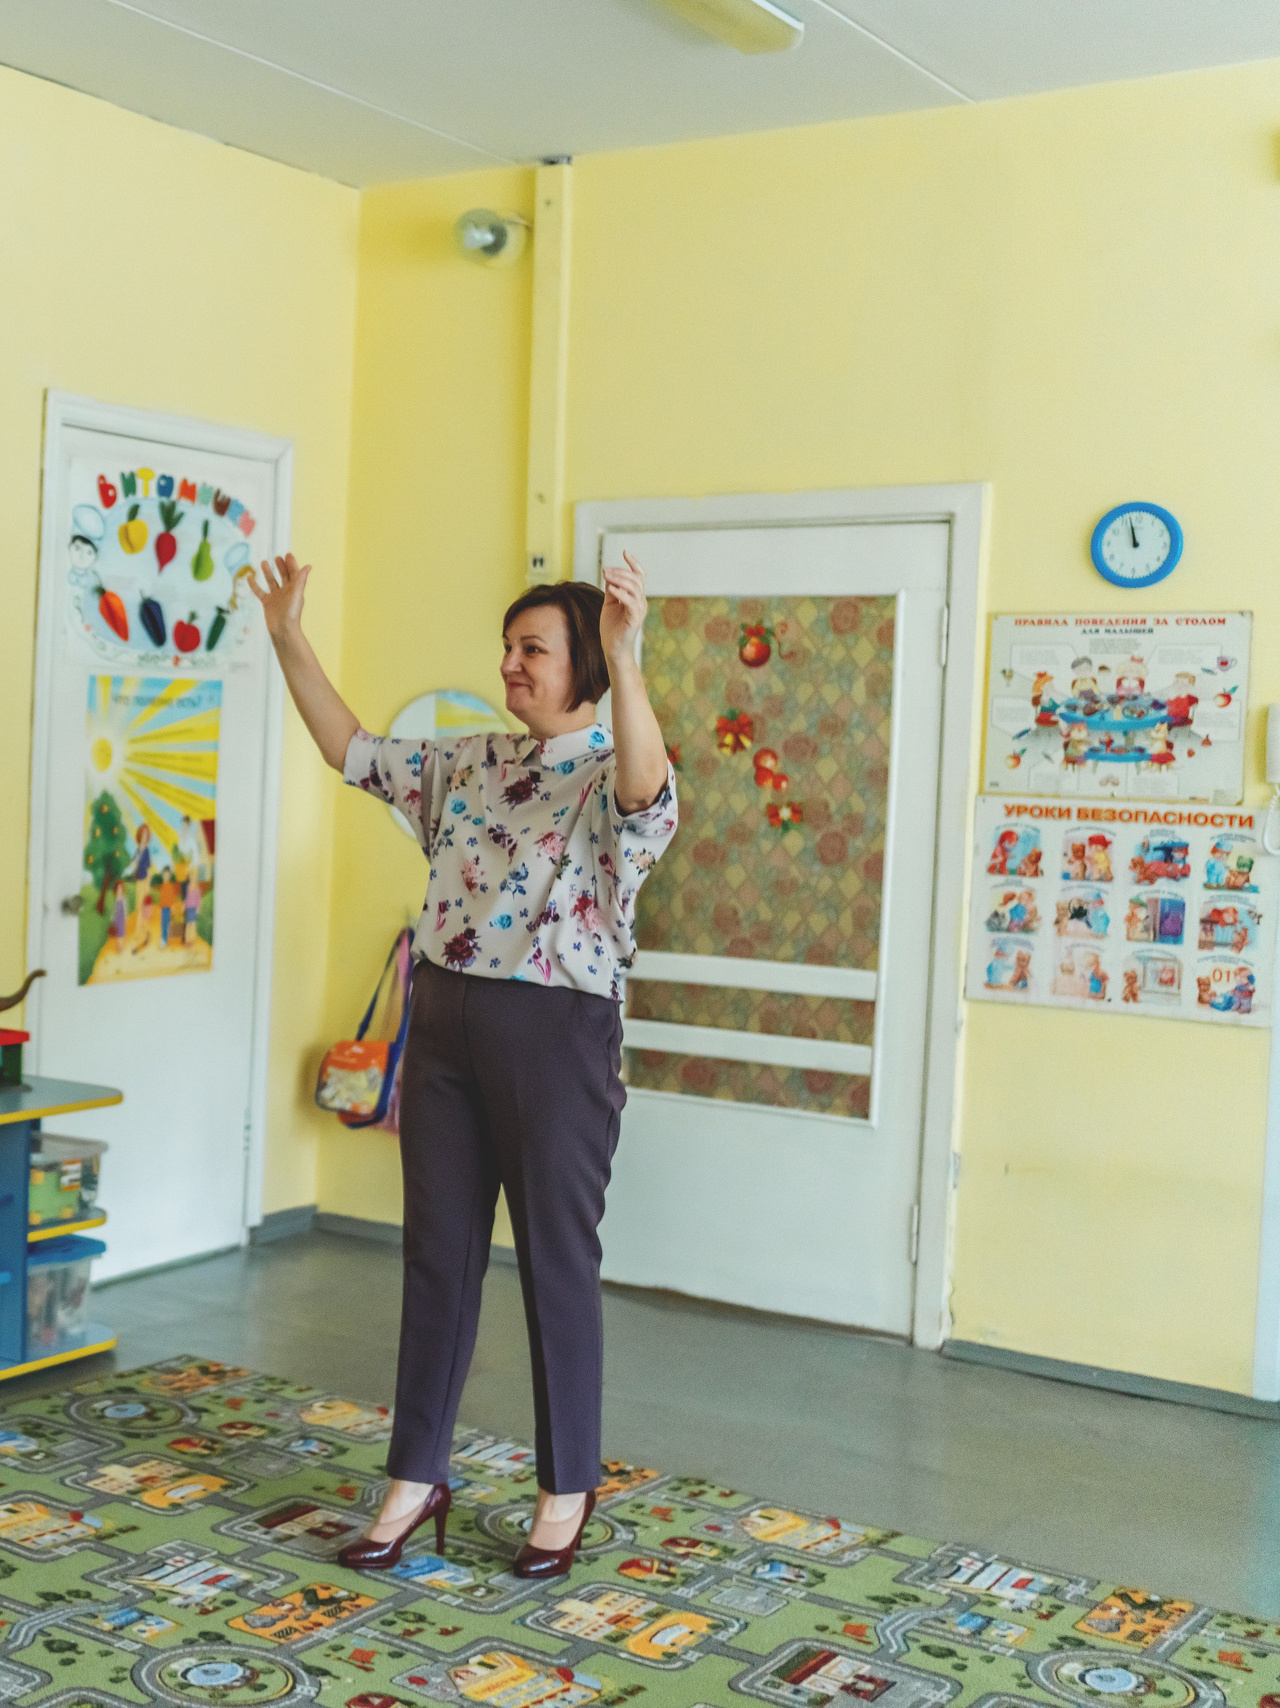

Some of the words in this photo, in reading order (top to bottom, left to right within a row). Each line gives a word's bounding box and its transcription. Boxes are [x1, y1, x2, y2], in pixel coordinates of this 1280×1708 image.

[1014, 617, 1069, 627] ПРАВИЛА
[1074, 617, 1147, 627] ПОВЕДЕНИЯ
[1153, 617, 1168, 626] ЗА
[1175, 616, 1227, 626] СТОЛОМ
[1003, 803, 1071, 820] УРОКИ
[1076, 807, 1255, 828] БЕЗОПАСНОСТИ
